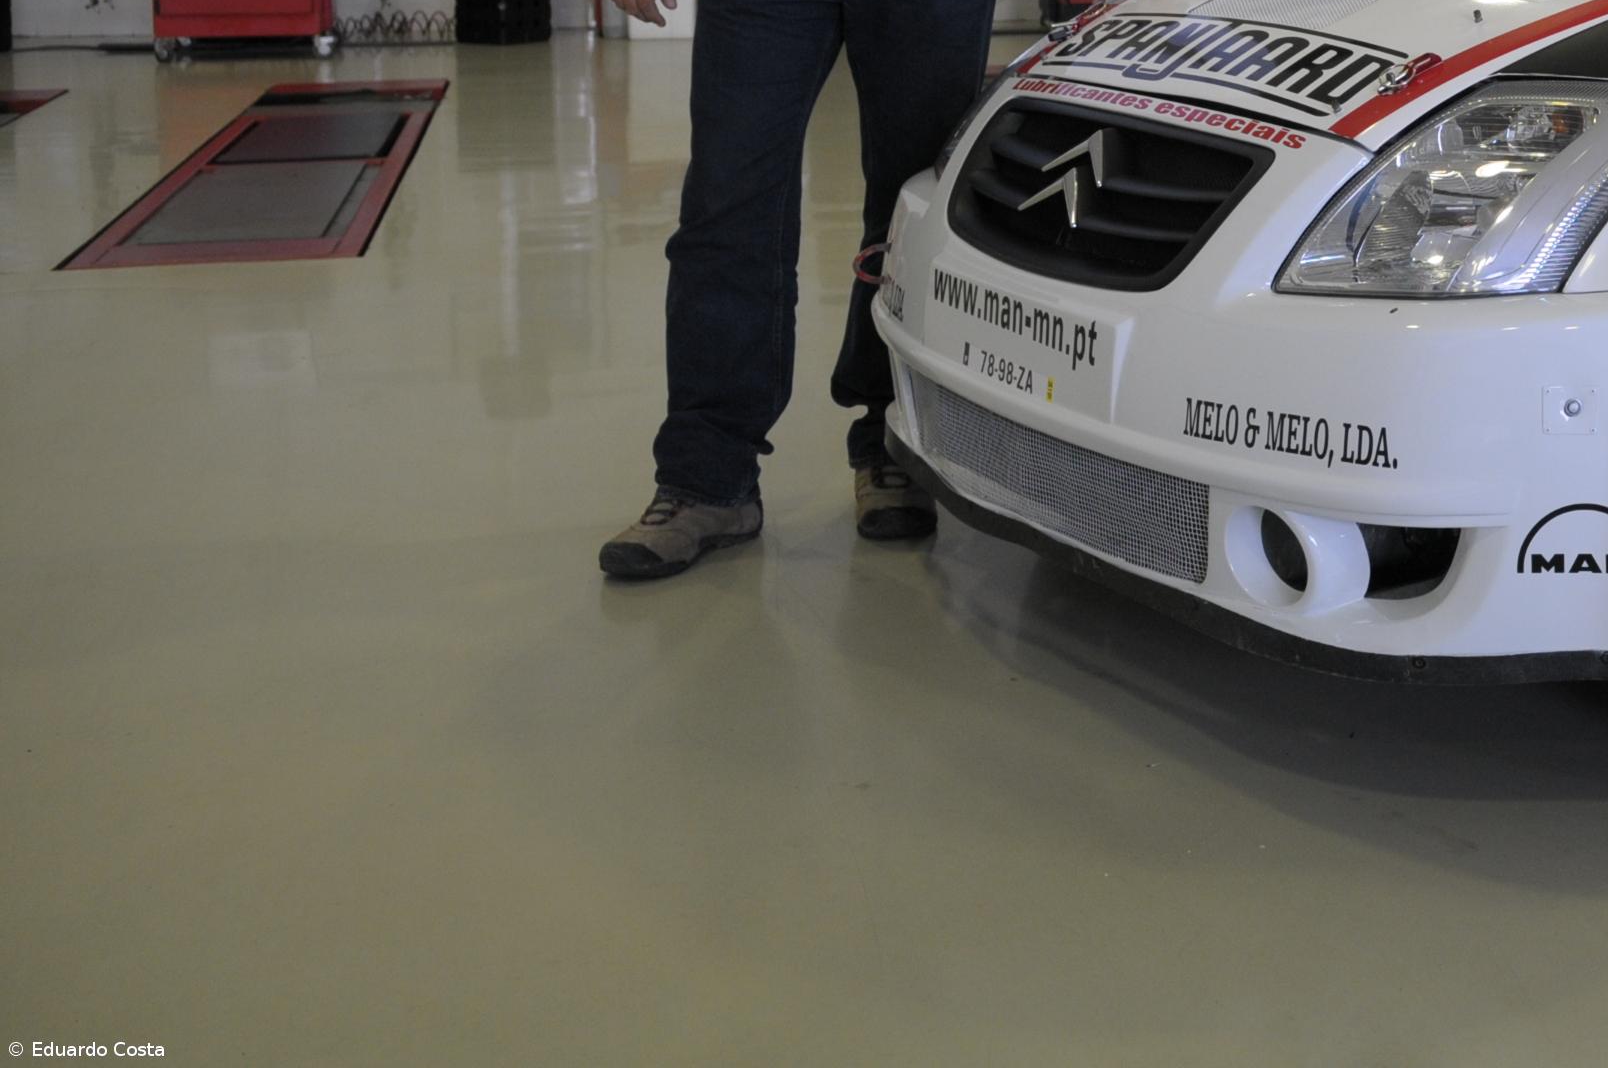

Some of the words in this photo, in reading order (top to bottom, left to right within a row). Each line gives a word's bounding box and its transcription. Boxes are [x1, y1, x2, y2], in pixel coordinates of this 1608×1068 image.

[1054, 18, 1398, 105] SPANJAARD
[1012, 79, 1156, 111] Lubrificantes
[1155, 97, 1307, 150] especiais
[933, 268, 1098, 371] www.man-mn.pt
[980, 350, 1033, 395] 78-98-ZA
[1184, 397, 1239, 445] MELO
[1245, 407, 1260, 448] &
[1265, 411, 1334, 468] MELO,
[1340, 422, 1398, 469] LDA.
